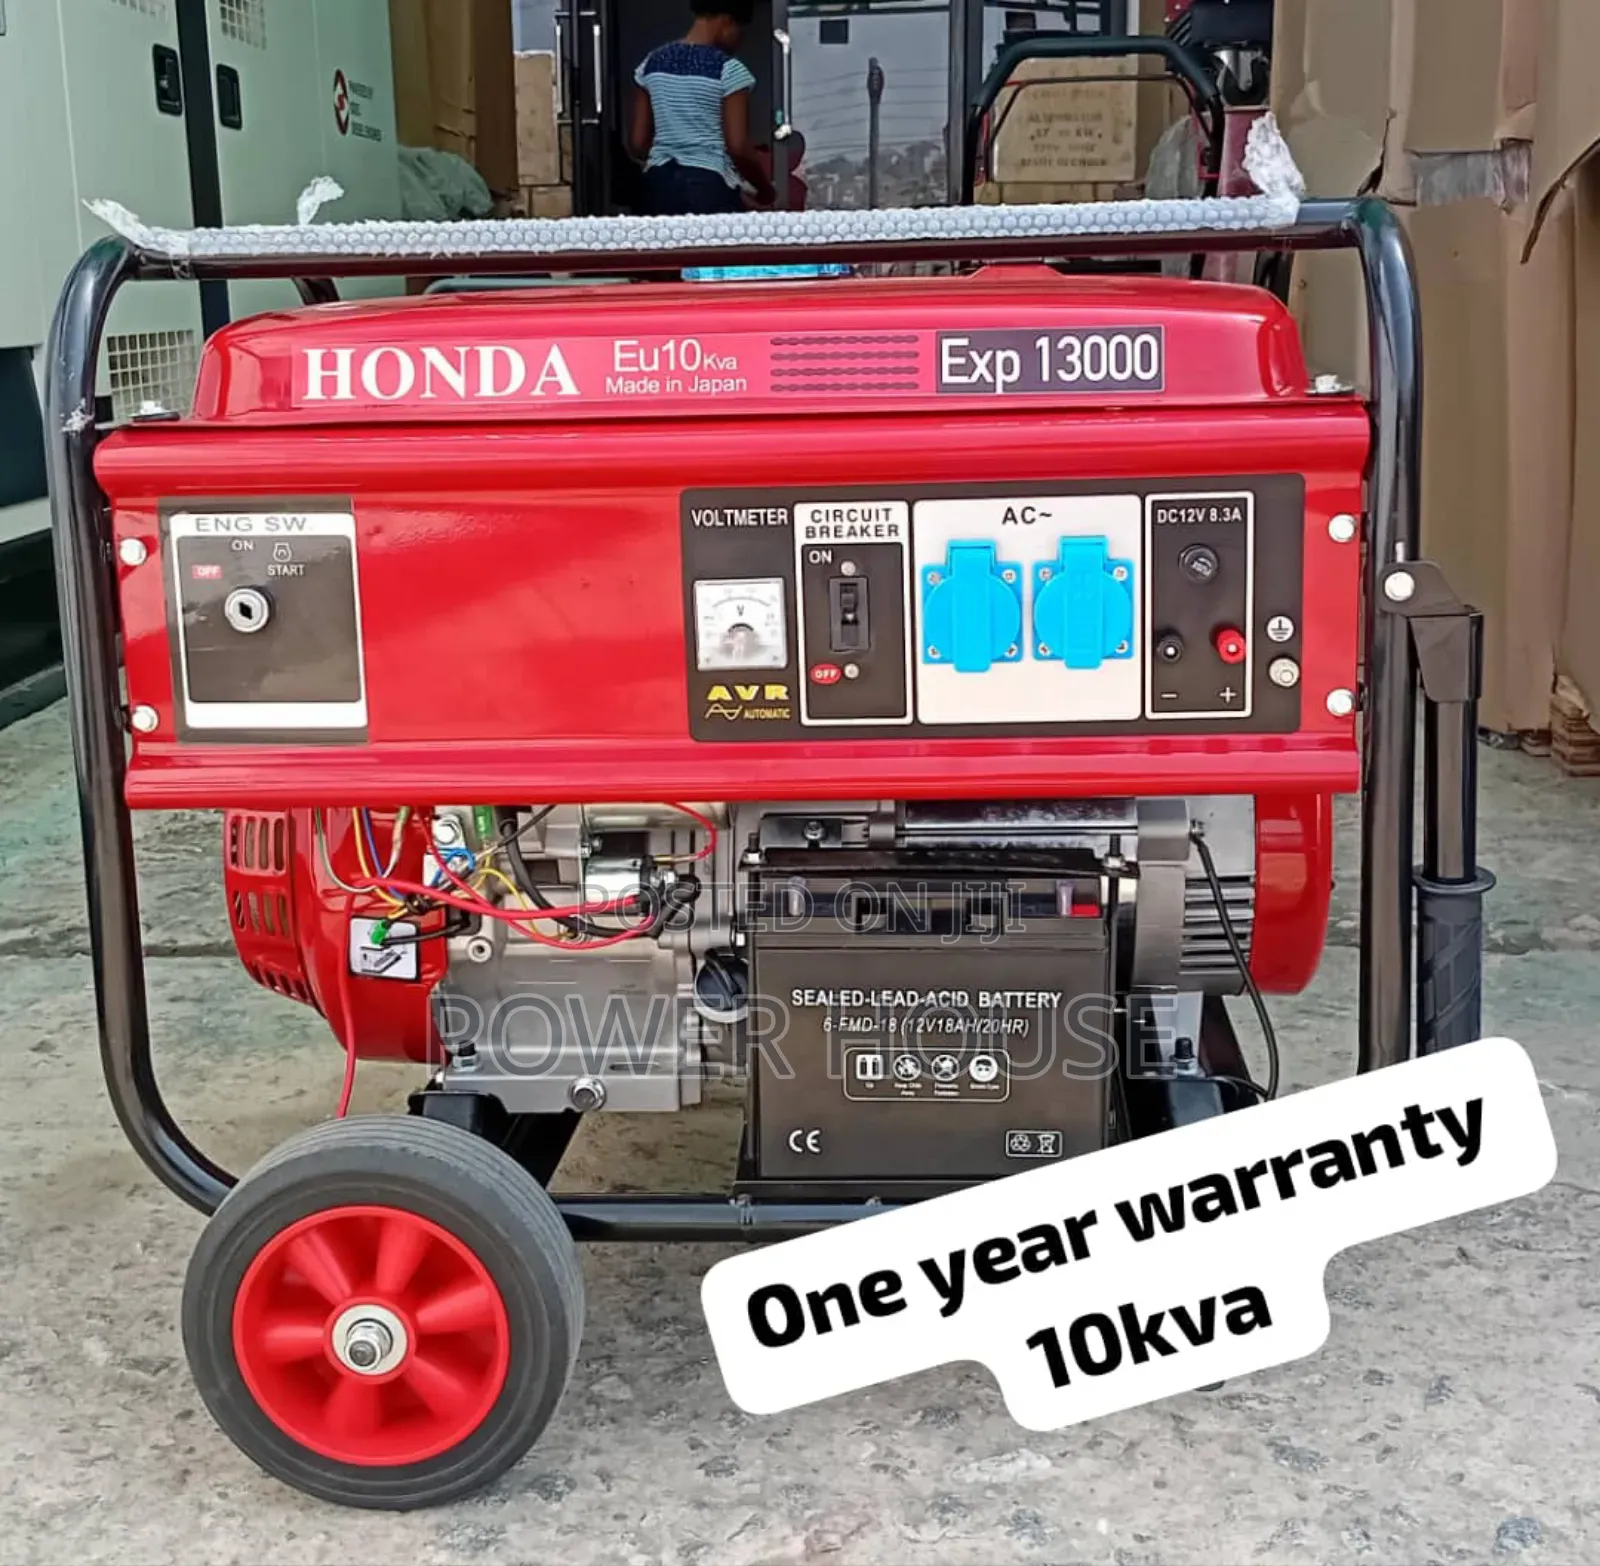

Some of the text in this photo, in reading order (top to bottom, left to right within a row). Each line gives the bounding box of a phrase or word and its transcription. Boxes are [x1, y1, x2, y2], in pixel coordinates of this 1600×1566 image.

[941, 334, 1159, 393] Exp 13000
[302, 344, 580, 401] HONDA
[605, 375, 748, 395] Made in Japan
[691, 508, 789, 527] VOLTMETER
[810, 508, 893, 523] CIRCUIT
[1157, 507, 1242, 523] DC12V 8.3A
[195, 515, 307, 532] ENG SW
[804, 524, 900, 539] BREAKER
[231, 540, 254, 551] ON
[808, 550, 832, 565] ON
[197, 564, 221, 576] OFF
[267, 564, 305, 576] START
[736, 604, 745, 616] V
[815, 668, 838, 680] OFF
[707, 685, 790, 701] AVR
[743, 708, 792, 720] AUTOMATIC
[791, 989, 1063, 1009] SEALED-LEAD-ACID BATTERY
[900, 1019, 1030, 1038] (12V18AH/20HR)
[788, 1130, 821, 1153] CE
